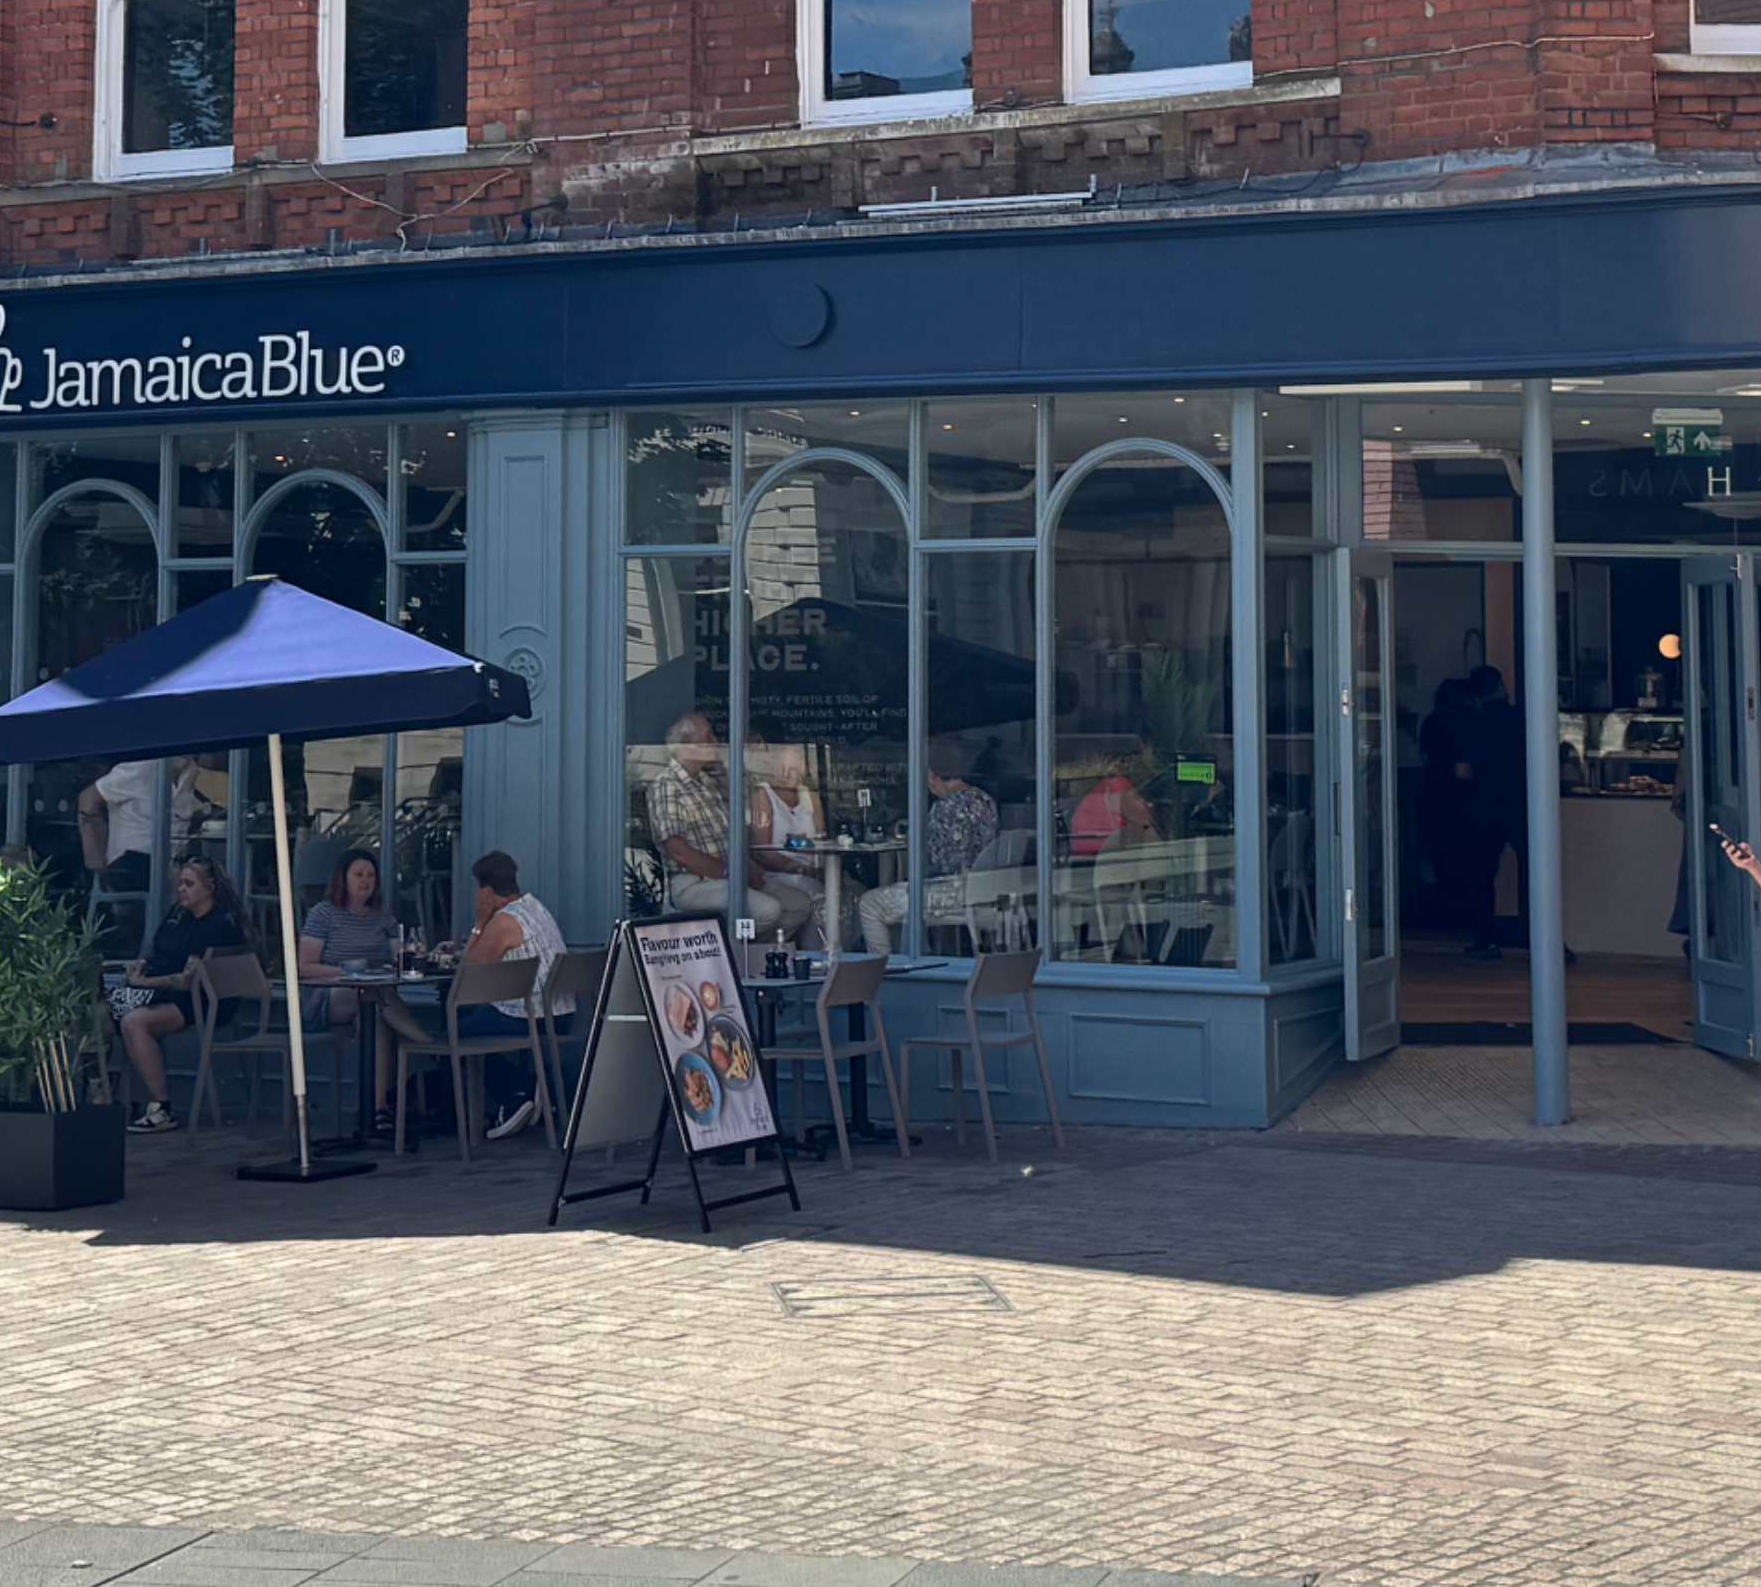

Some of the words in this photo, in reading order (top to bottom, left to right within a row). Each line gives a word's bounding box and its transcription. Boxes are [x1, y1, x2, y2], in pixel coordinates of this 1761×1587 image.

[787, 694, 834, 705] FERTILE
[640, 935, 681, 952] Flavour
[682, 930, 719, 948] worth
